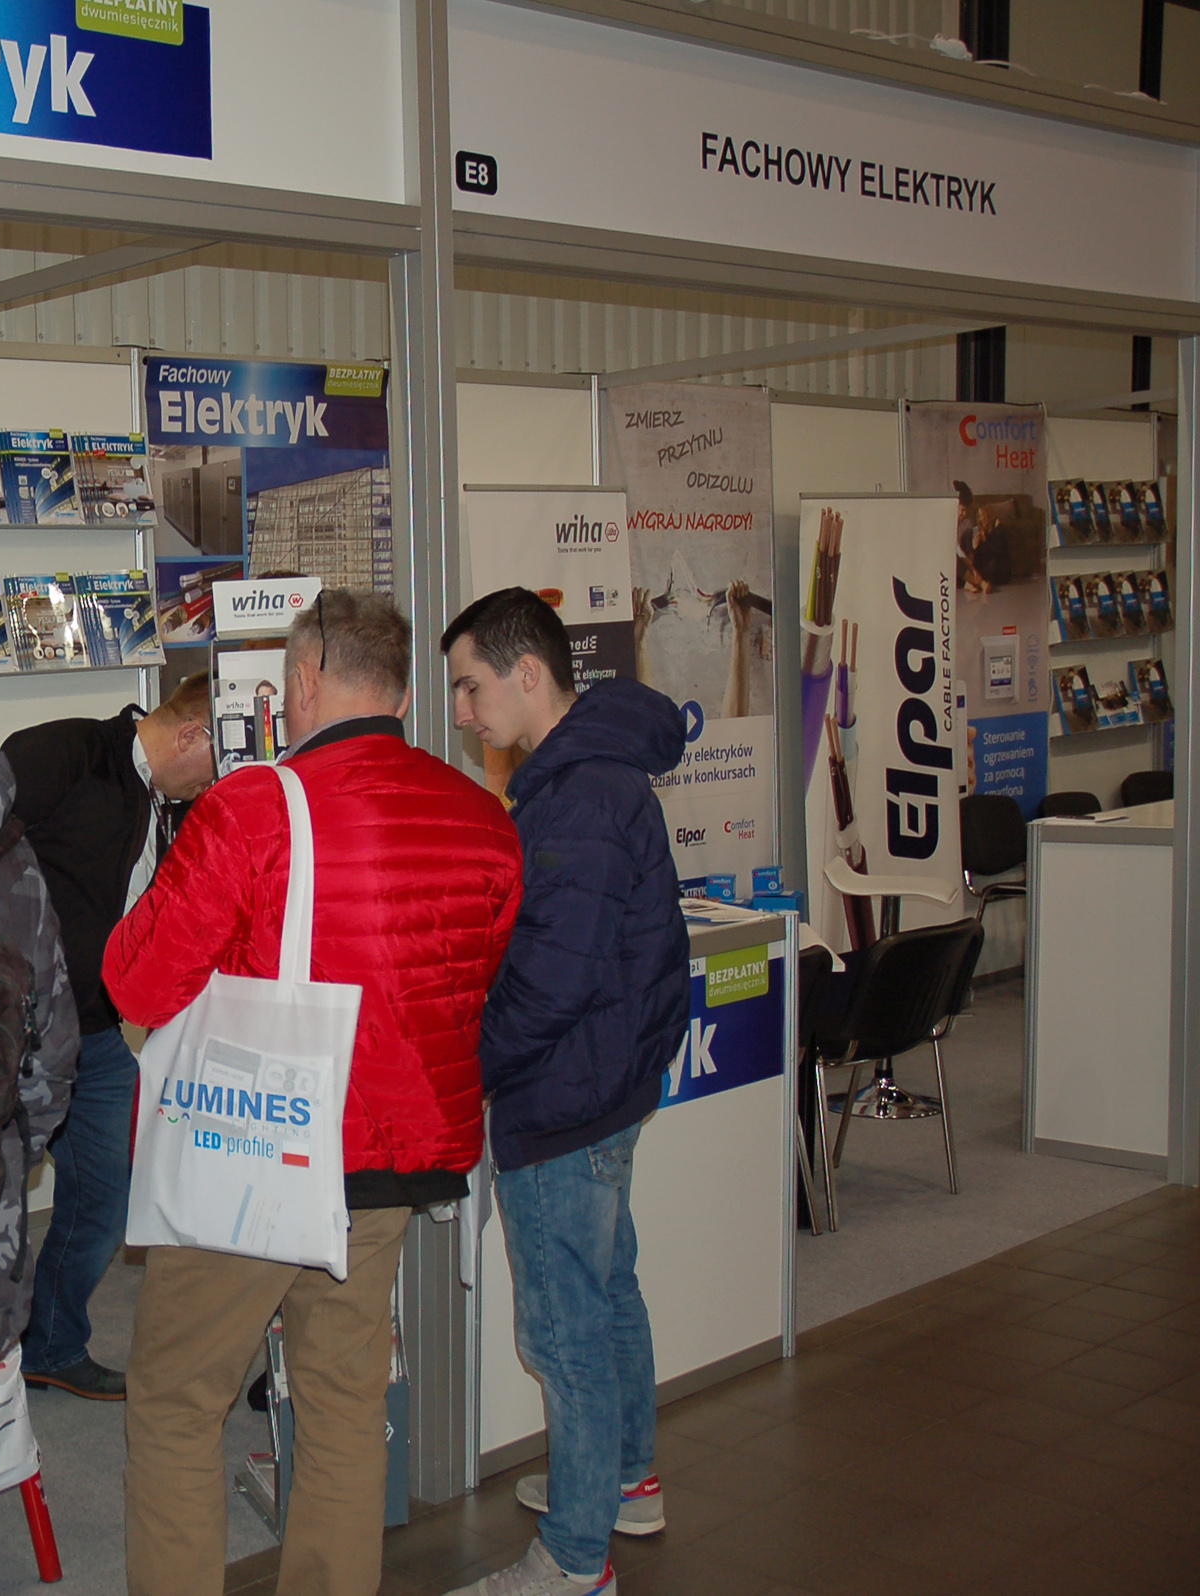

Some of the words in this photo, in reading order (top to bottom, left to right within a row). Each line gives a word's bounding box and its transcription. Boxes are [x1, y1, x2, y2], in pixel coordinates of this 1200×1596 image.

[81, 4, 179, 32] dwumiesięcznik
[464, 160, 489, 186] E8
[701, 132, 852, 193] FACHOWY
[860, 162, 997, 215] ELEKTRYK
[159, 364, 232, 386] Fachowy
[329, 368, 381, 381] BEZPŁATNY
[159, 391, 329, 444] Elektryk
[625, 411, 684, 429] ZMIERZ
[959, 414, 1037, 446] Comfort
[11, 438, 54, 450] Elektryk
[91, 441, 134, 452] ELEKTRYK
[657, 427, 723, 467] PRZYTNIJ
[996, 444, 1035, 469] Heat
[687, 471, 753, 494] ODIZOLUJ
[555, 514, 603, 543] wiha
[626, 509, 682, 531] WYGRAJ
[686, 511, 753, 531] NAGRODY!
[93, 579, 135, 590] Elektryk
[232, 590, 285, 611] wiha
[940, 571, 951, 661] FACTORY
[942, 668, 952, 732] CABLE
[885, 575, 953, 860] Elpar
[983, 729, 1026, 745] Sterowanie
[694, 743, 753, 764] elektryków
[983, 746, 1035, 766] ogrzewaniem
[683, 775, 692, 785] w
[694, 764, 756, 783] konkursach
[983, 771, 994, 783] za
[995, 766, 1026, 784] pomocą
[724, 819, 755, 833] Comfort
[738, 830, 755, 840] Heat
[676, 828, 706, 847] Elpar
[709, 960, 766, 985] BEZPŁATNY
[709, 977, 766, 997] dwumiesięcznik
[159, 1077, 311, 1126] LUMINES
[194, 1130, 221, 1150] LED
[227, 1135, 274, 1158] profile
